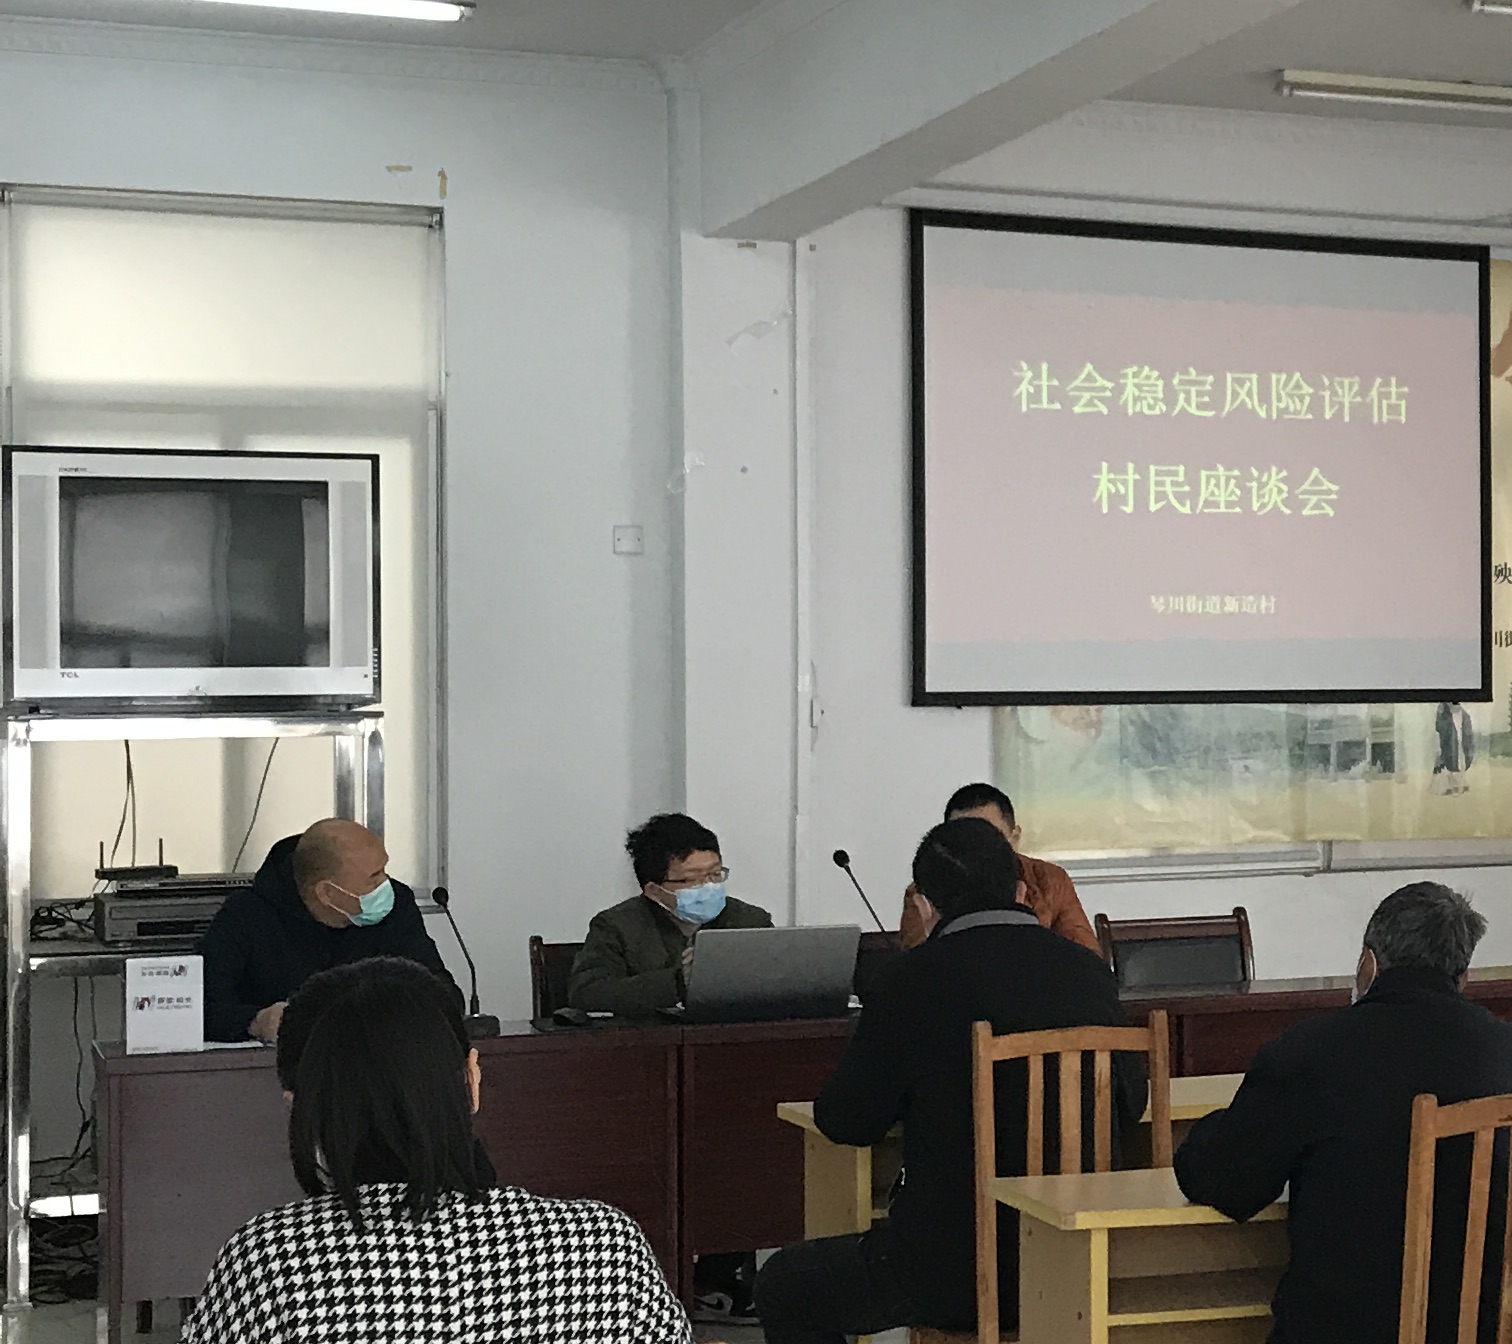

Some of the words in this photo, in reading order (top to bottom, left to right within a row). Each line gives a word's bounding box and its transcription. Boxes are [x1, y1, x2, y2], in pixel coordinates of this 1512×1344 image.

[1012, 360, 1410, 425] 社会稳定风险评估
[1092, 461, 1341, 517] 村民座谈会
[59, 671, 80, 679] TCL
